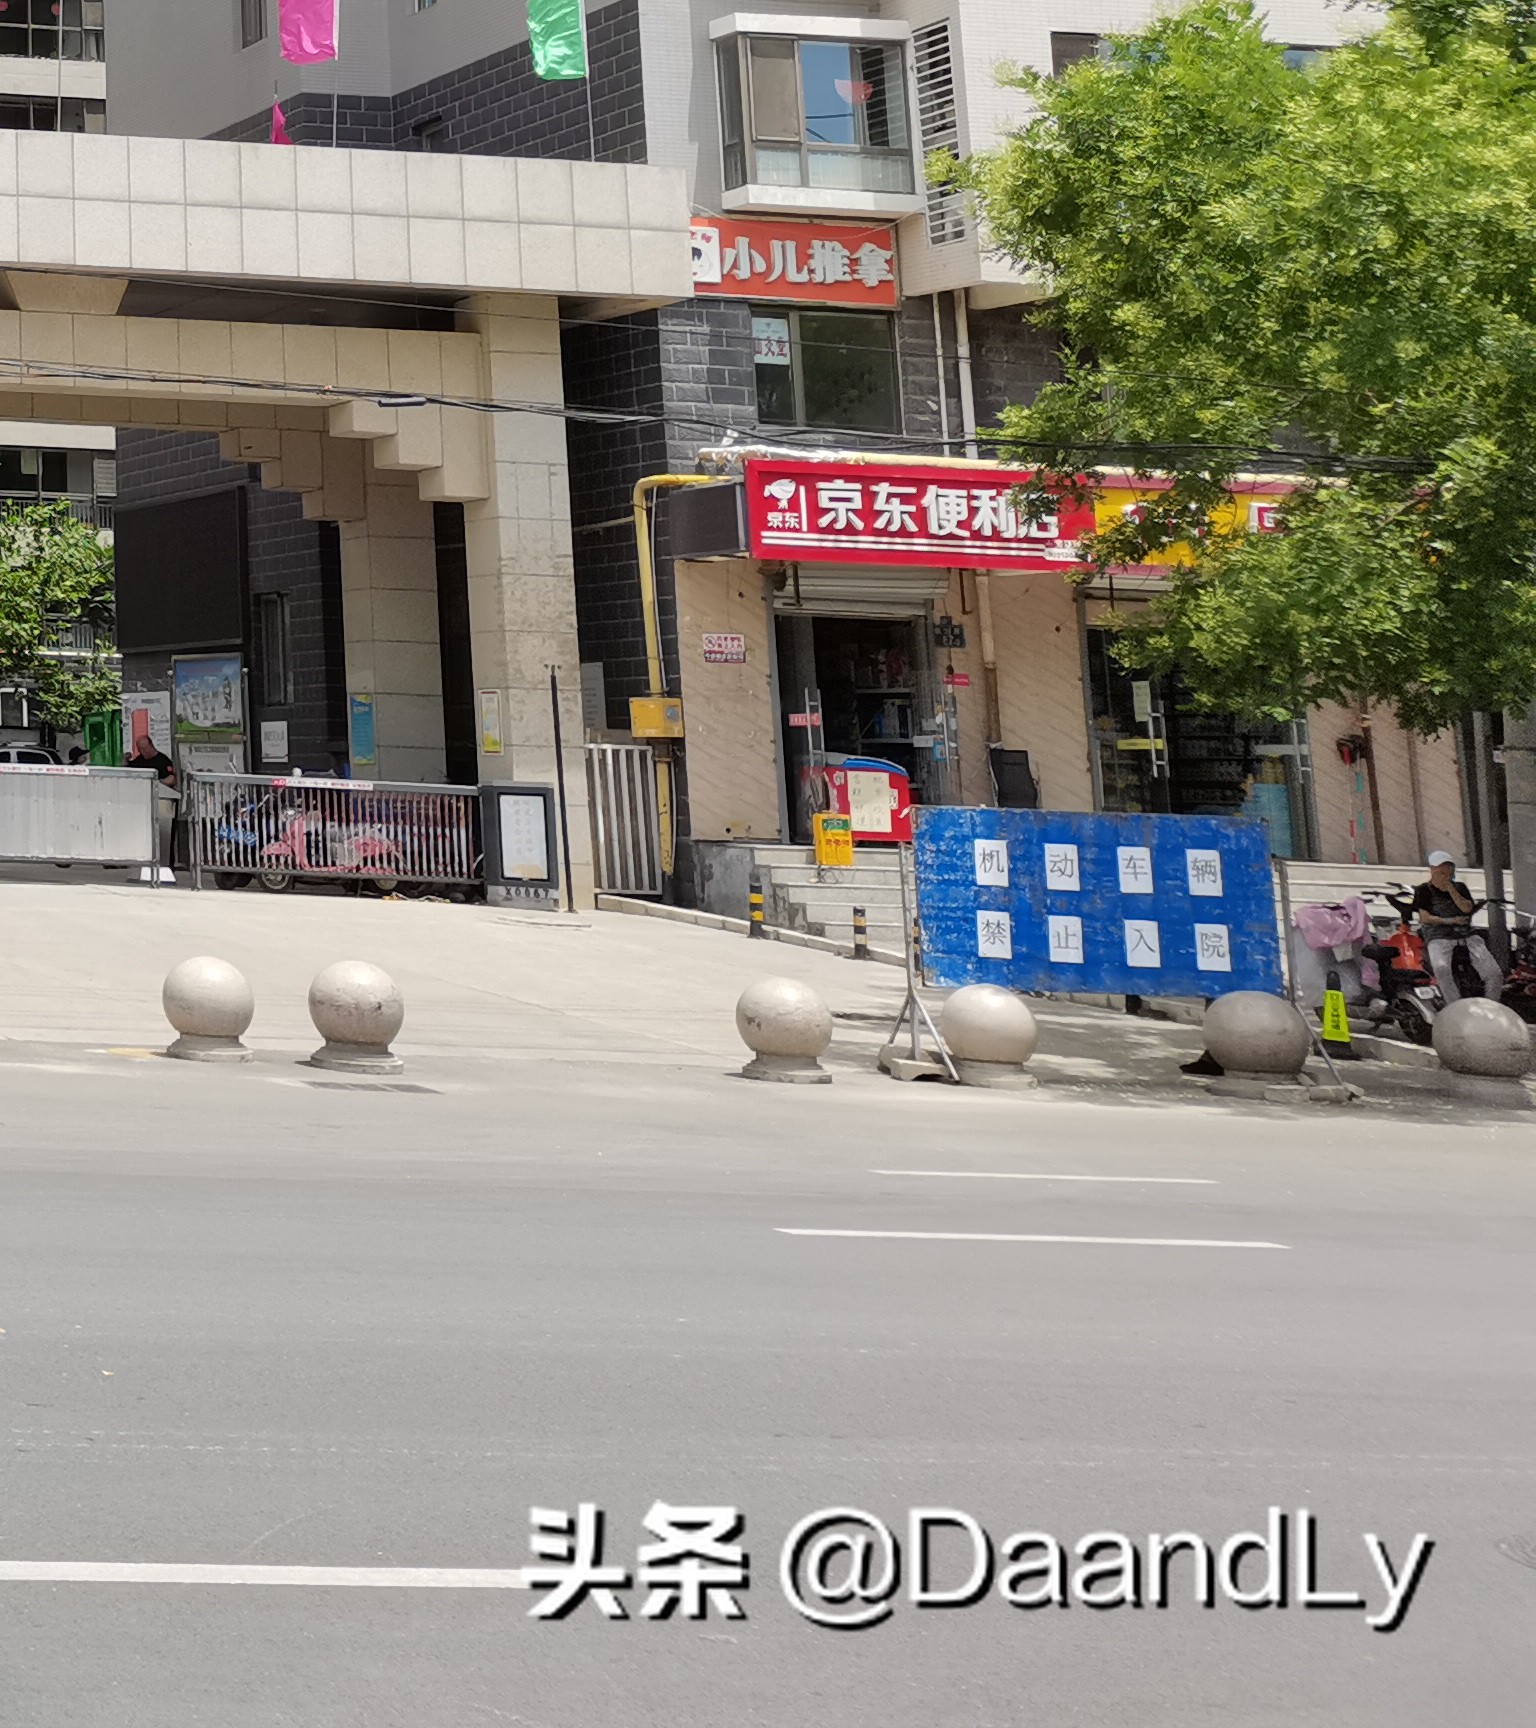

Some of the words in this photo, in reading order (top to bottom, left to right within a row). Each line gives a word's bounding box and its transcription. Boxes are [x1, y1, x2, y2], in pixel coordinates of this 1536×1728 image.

[723, 236, 894, 287] 小儿推拿
[767, 511, 801, 531] 京东
[978, 847, 1218, 885] 机动车辆
[980, 919, 1226, 960] 禁止入院
